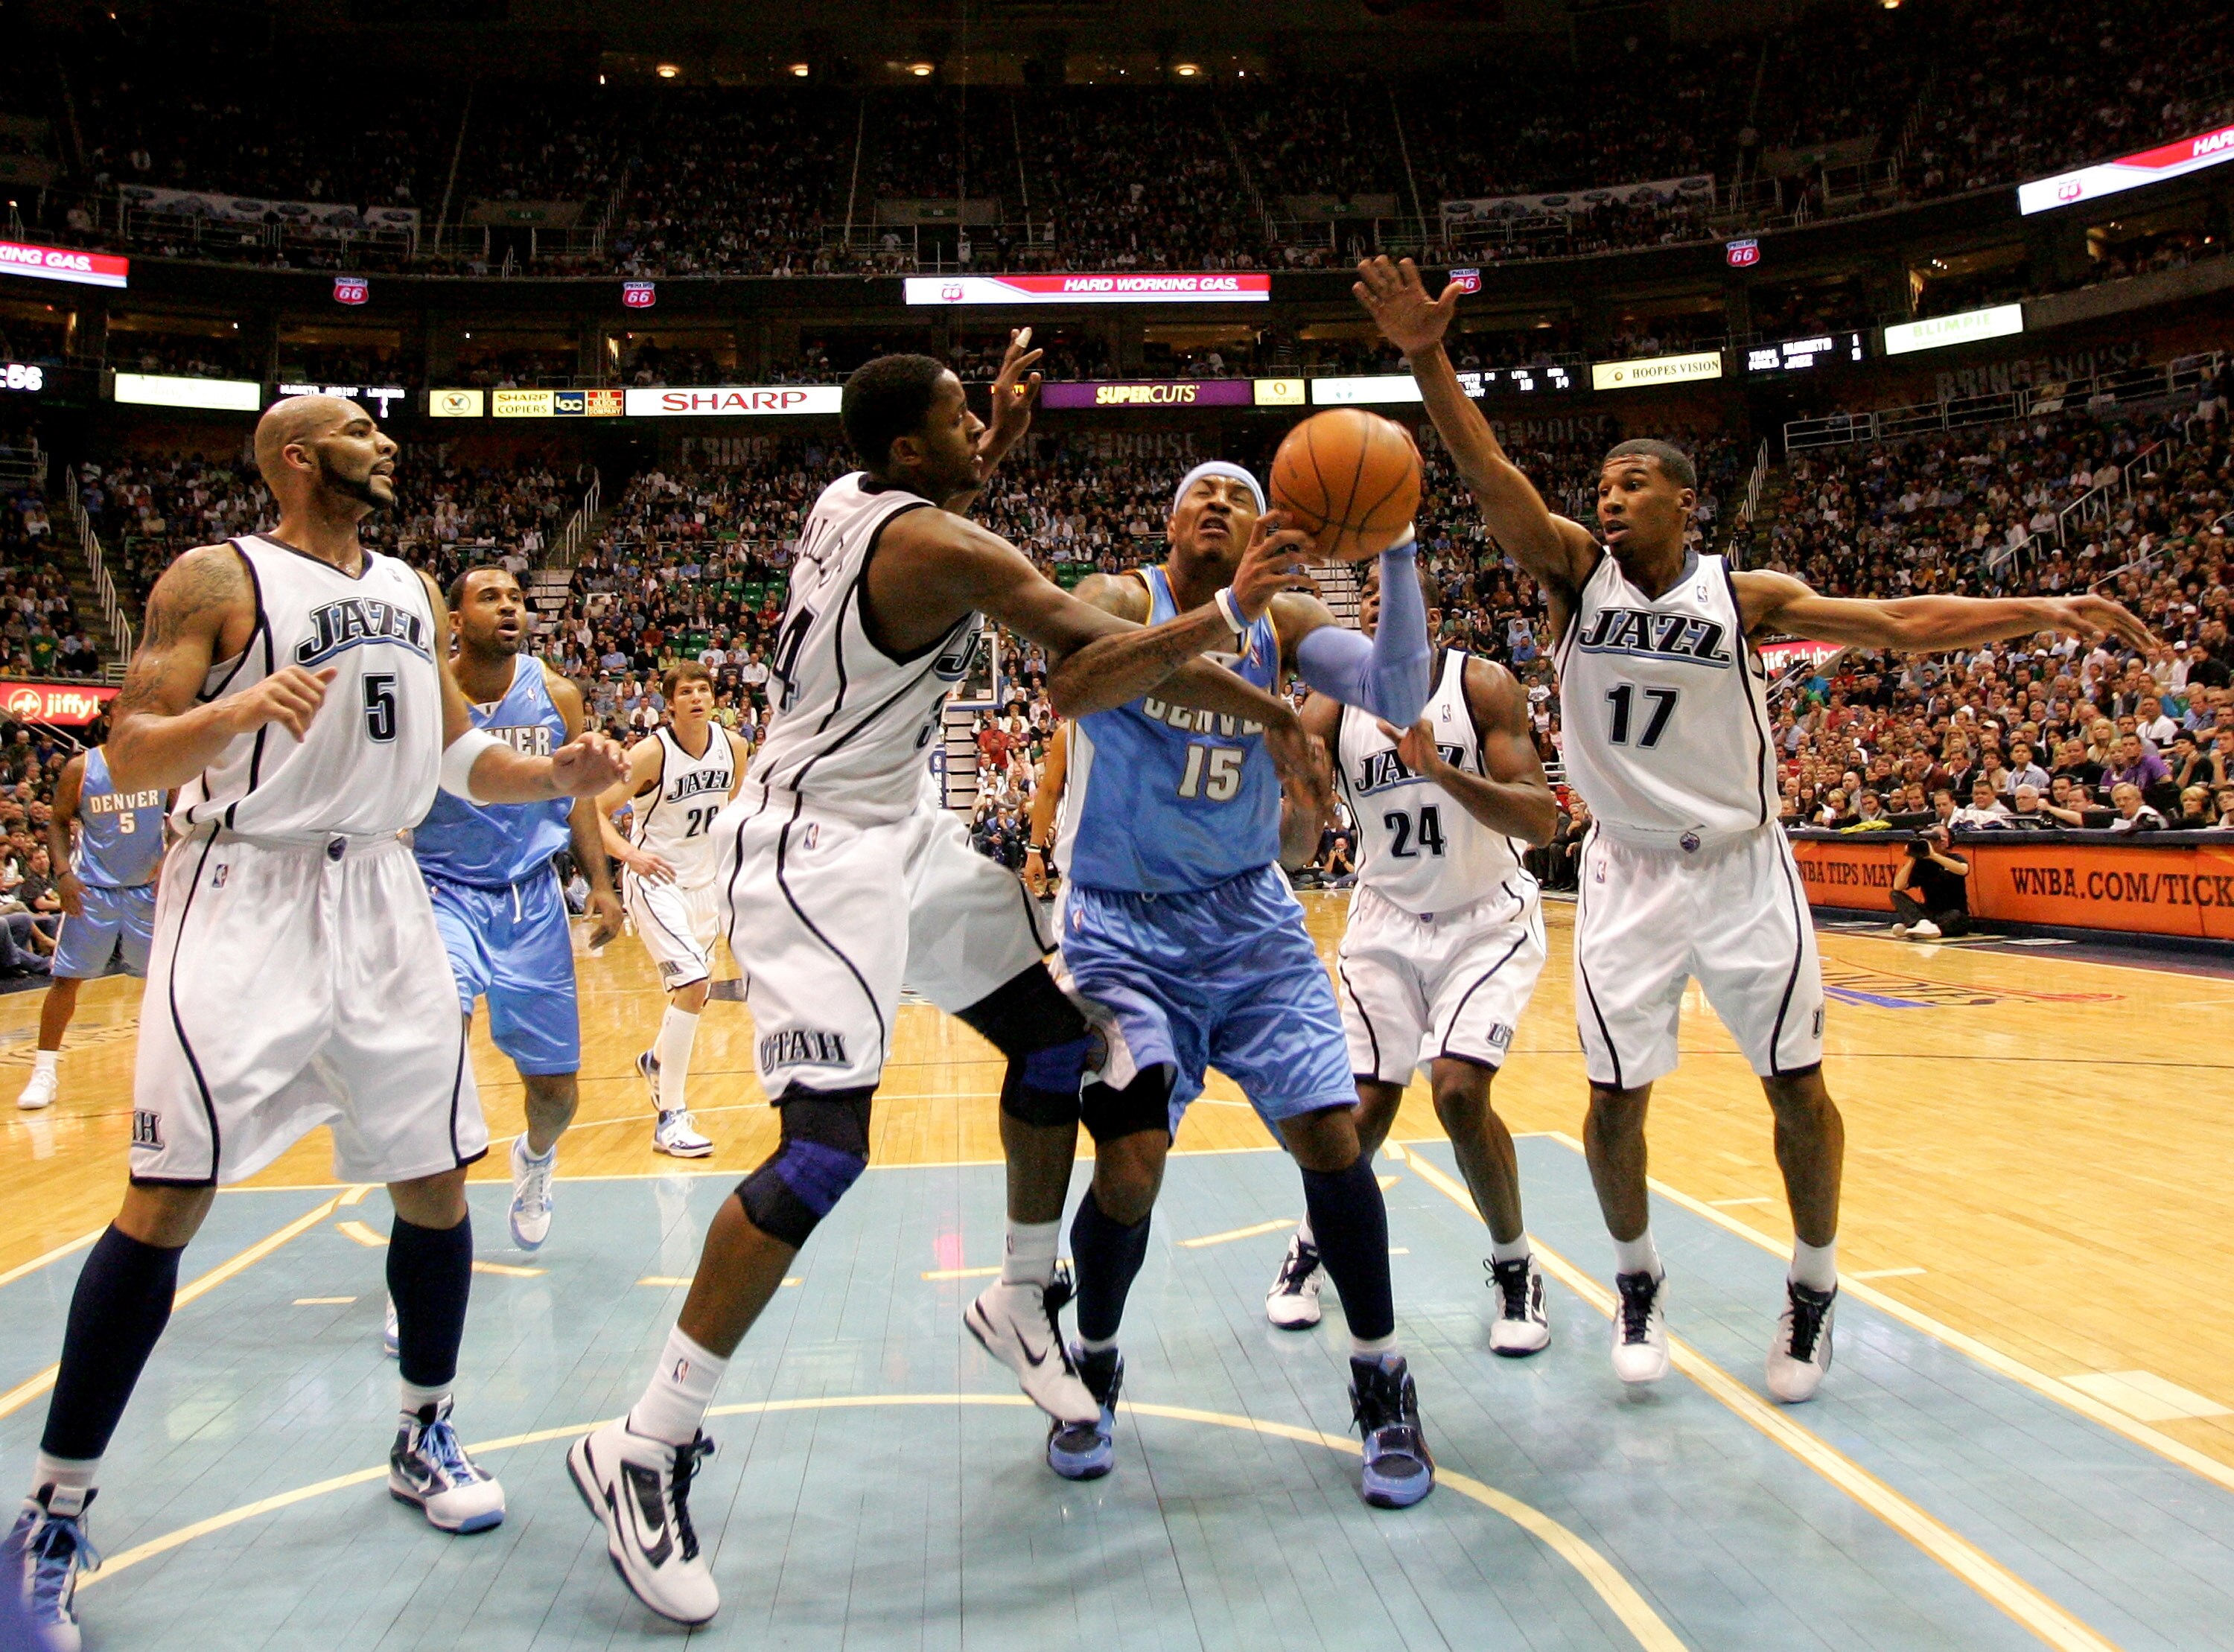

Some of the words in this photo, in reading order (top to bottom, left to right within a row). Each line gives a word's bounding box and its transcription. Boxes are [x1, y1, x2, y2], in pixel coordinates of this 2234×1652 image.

[2192, 130, 2234, 156] HAR
[45, 252, 92, 272] GAS.
[1731, 249, 1754, 263] 66
[340, 287, 363, 300] 66
[1064, 278, 1113, 291] HARD
[1116, 278, 1197, 291] WORKING
[1200, 278, 1239, 291] GAS.
[628, 291, 651, 303] 66
[1913, 313, 1990, 337] BLIMPIE
[1632, 364, 1676, 378] HOOPES
[1680, 360, 1720, 373] VISION
[497, 393, 548, 402] SHARP
[662, 391, 808, 412] SHARP
[1095, 385, 1196, 404] SUPERCUTS
[498, 406, 547, 414] COPIERS
[295, 597, 433, 667] JAZZ
[1579, 607, 1733, 669] JAZZ
[362, 672, 396, 743] 5
[1604, 682, 1680, 750] 17
[1177, 744, 1245, 802] 15
[1354, 742, 1477, 797] JAZ
[666, 768, 731, 803] JAZZ
[90, 789, 159, 814] DENVER
[119, 811, 135, 834] 5
[1383, 804, 1448, 859] 24
[1796, 860, 1824, 883] NBA
[1827, 861, 1859, 885] TIPS
[1862, 864, 1898, 888] MAY
[760, 1029, 850, 1077] UTAH
